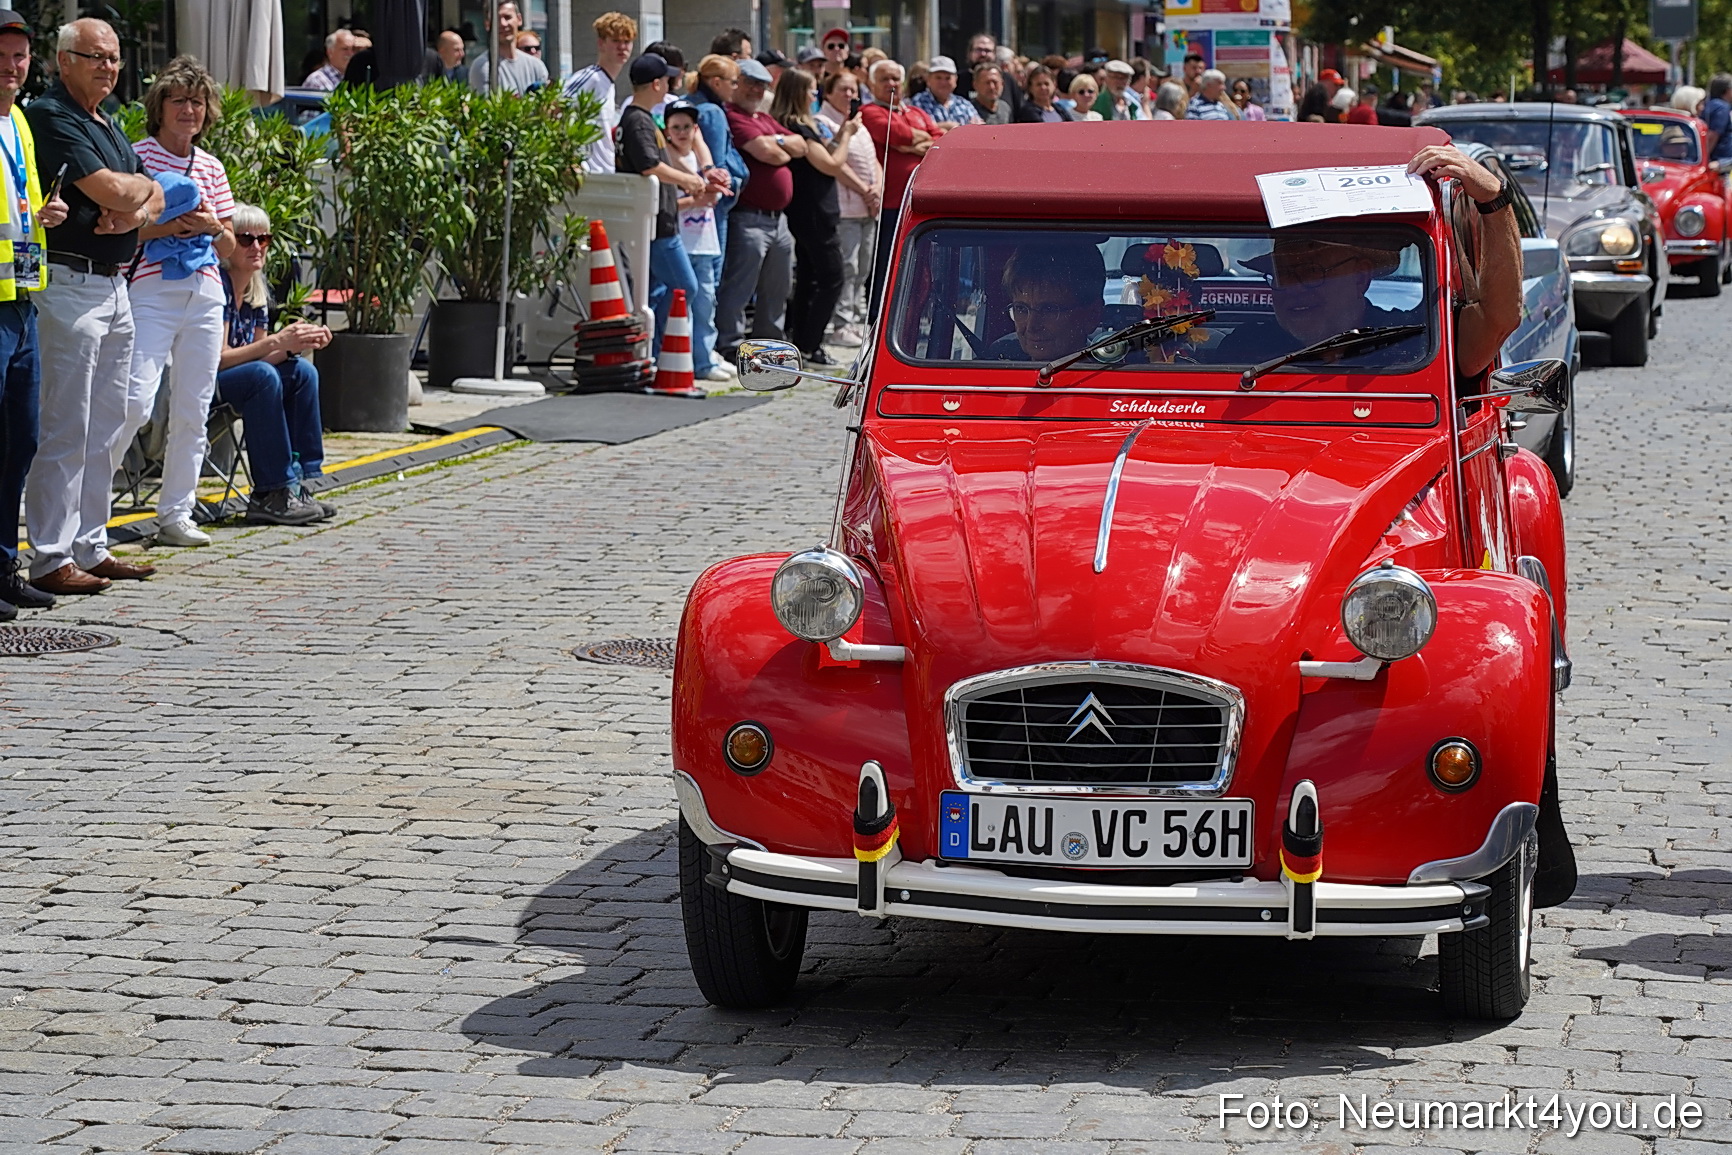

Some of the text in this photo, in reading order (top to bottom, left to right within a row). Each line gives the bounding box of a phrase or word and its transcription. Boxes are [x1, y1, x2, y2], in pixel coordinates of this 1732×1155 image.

[1338, 175, 1392, 188] 260
[1198, 293, 1249, 305] EGENDE
[1109, 399, 1206, 414] Schdudserla
[971, 803, 1054, 856] LAU
[1092, 809, 1149, 858] VC
[1162, 809, 1247, 858] 56H
[950, 832, 960, 847] D
